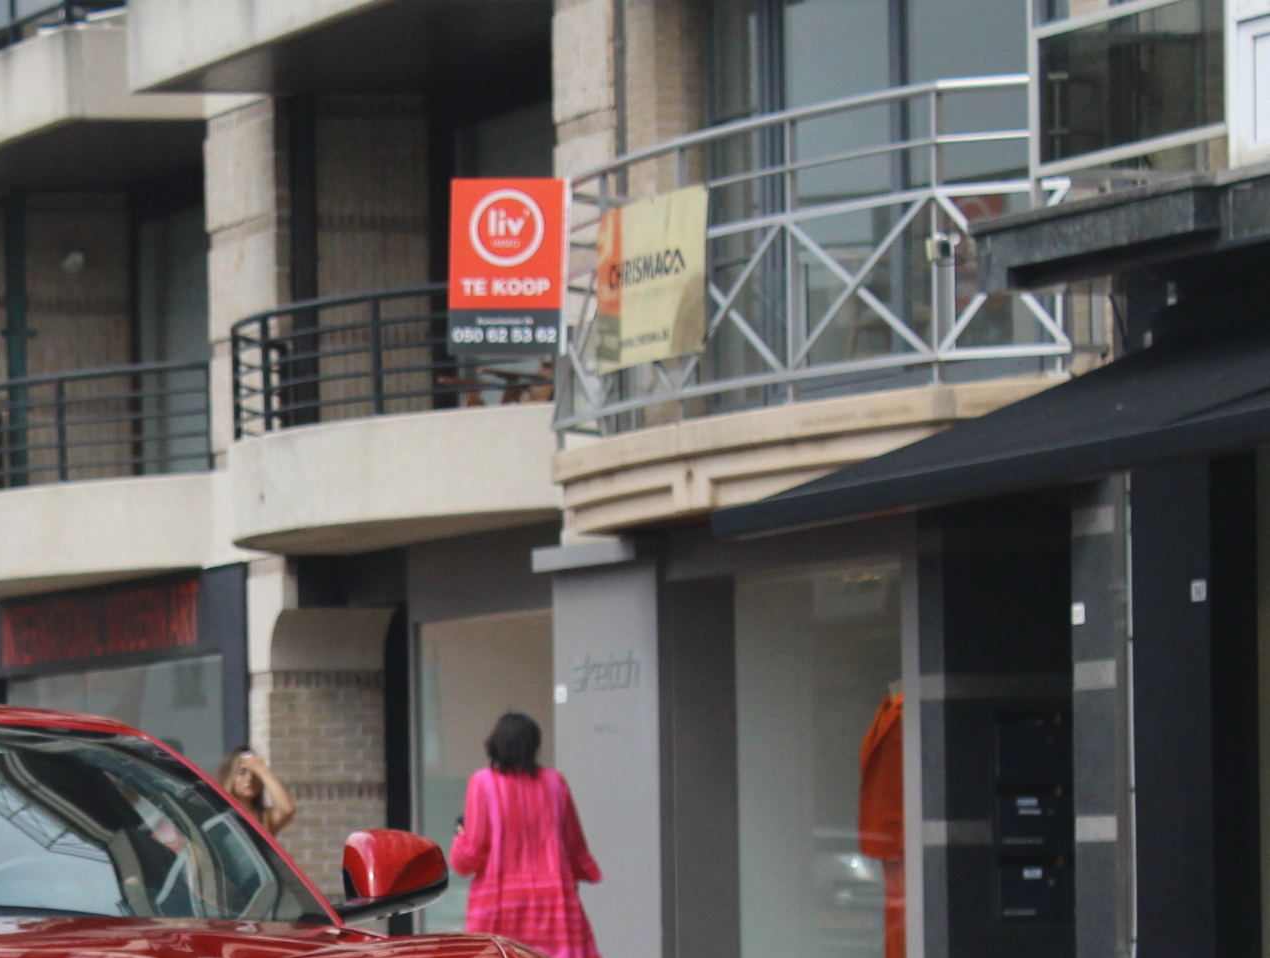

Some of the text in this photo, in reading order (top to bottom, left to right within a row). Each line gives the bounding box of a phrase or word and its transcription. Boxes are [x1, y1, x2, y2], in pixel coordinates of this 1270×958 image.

[461, 277, 552, 297] TE KOOP
[451, 326, 558, 344] 050 62 53 62
